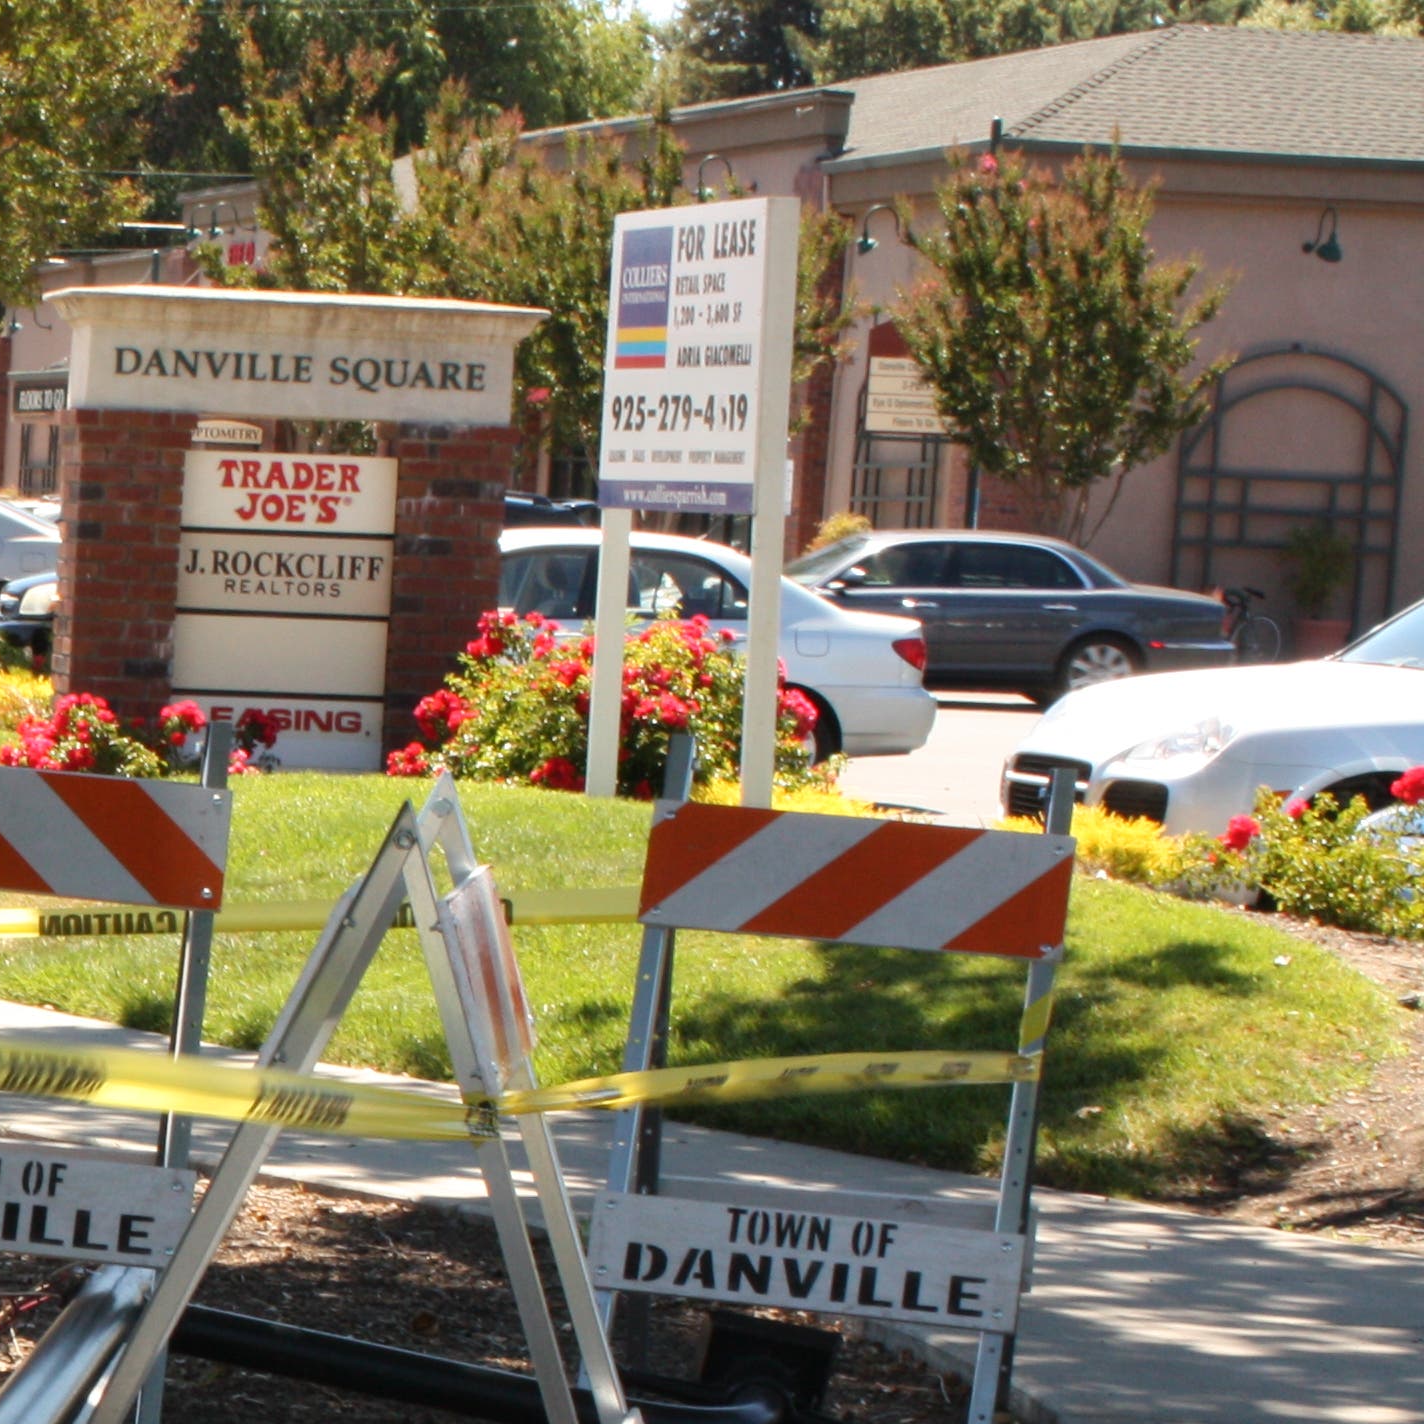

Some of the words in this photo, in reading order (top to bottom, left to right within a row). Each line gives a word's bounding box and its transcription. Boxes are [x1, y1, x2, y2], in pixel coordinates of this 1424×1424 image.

[677, 224, 706, 263] FOR
[713, 218, 757, 260] LEASE
[675, 274, 700, 297] RETAIL
[702, 271, 726, 295] SPACE
[113, 346, 313, 384] DANVILLE
[329, 355, 487, 392] SQUARE
[676, 345, 701, 368] ADRIA
[216, 458, 361, 493] TRADER
[234, 492, 340, 525] JOE'S
[184, 547, 206, 575] J.
[210, 552, 384, 582] ROCKCLIFF
[223, 577, 342, 599] REALTORS
[210, 706, 362, 734] EASING
[21, 1159, 69, 1198] OF
[726, 1207, 833, 1252] TOWN
[852, 1220, 900, 1259] OF
[622, 1241, 988, 1318] DANVILLE
